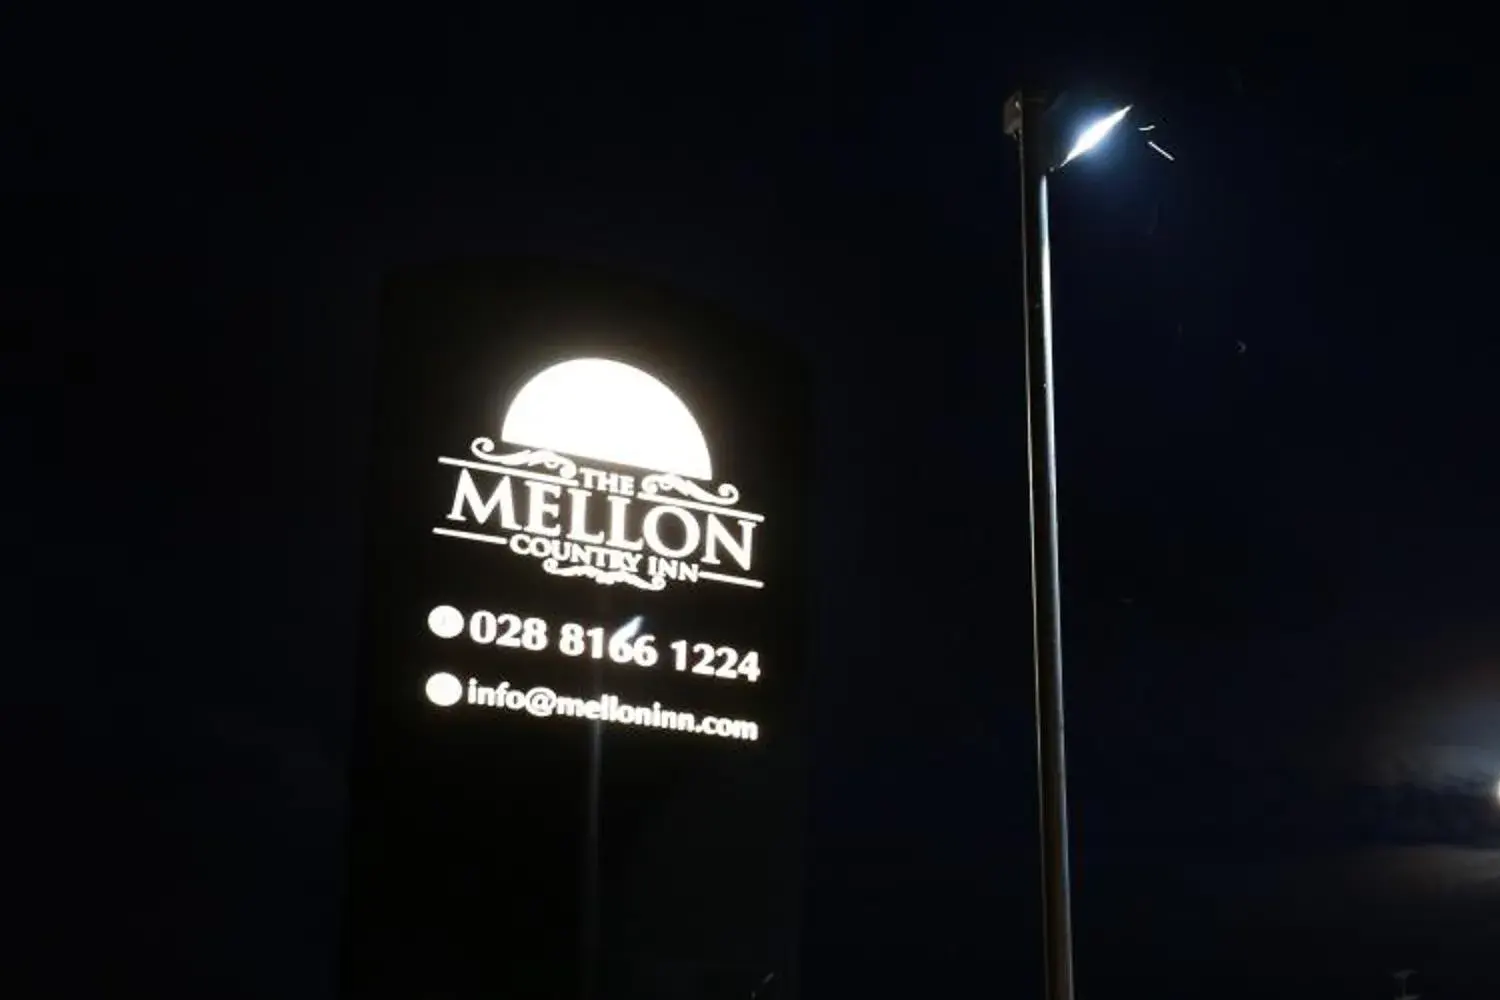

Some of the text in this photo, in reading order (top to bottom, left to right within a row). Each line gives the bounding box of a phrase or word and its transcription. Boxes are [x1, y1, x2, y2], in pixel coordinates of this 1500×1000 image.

[578, 466, 635, 495] THE
[447, 467, 757, 571] MELLON
[509, 533, 699, 582] COUNTRY INN
[470, 610, 761, 682] 028 8166 1224
[467, 677, 759, 741] info@melloninn.com
